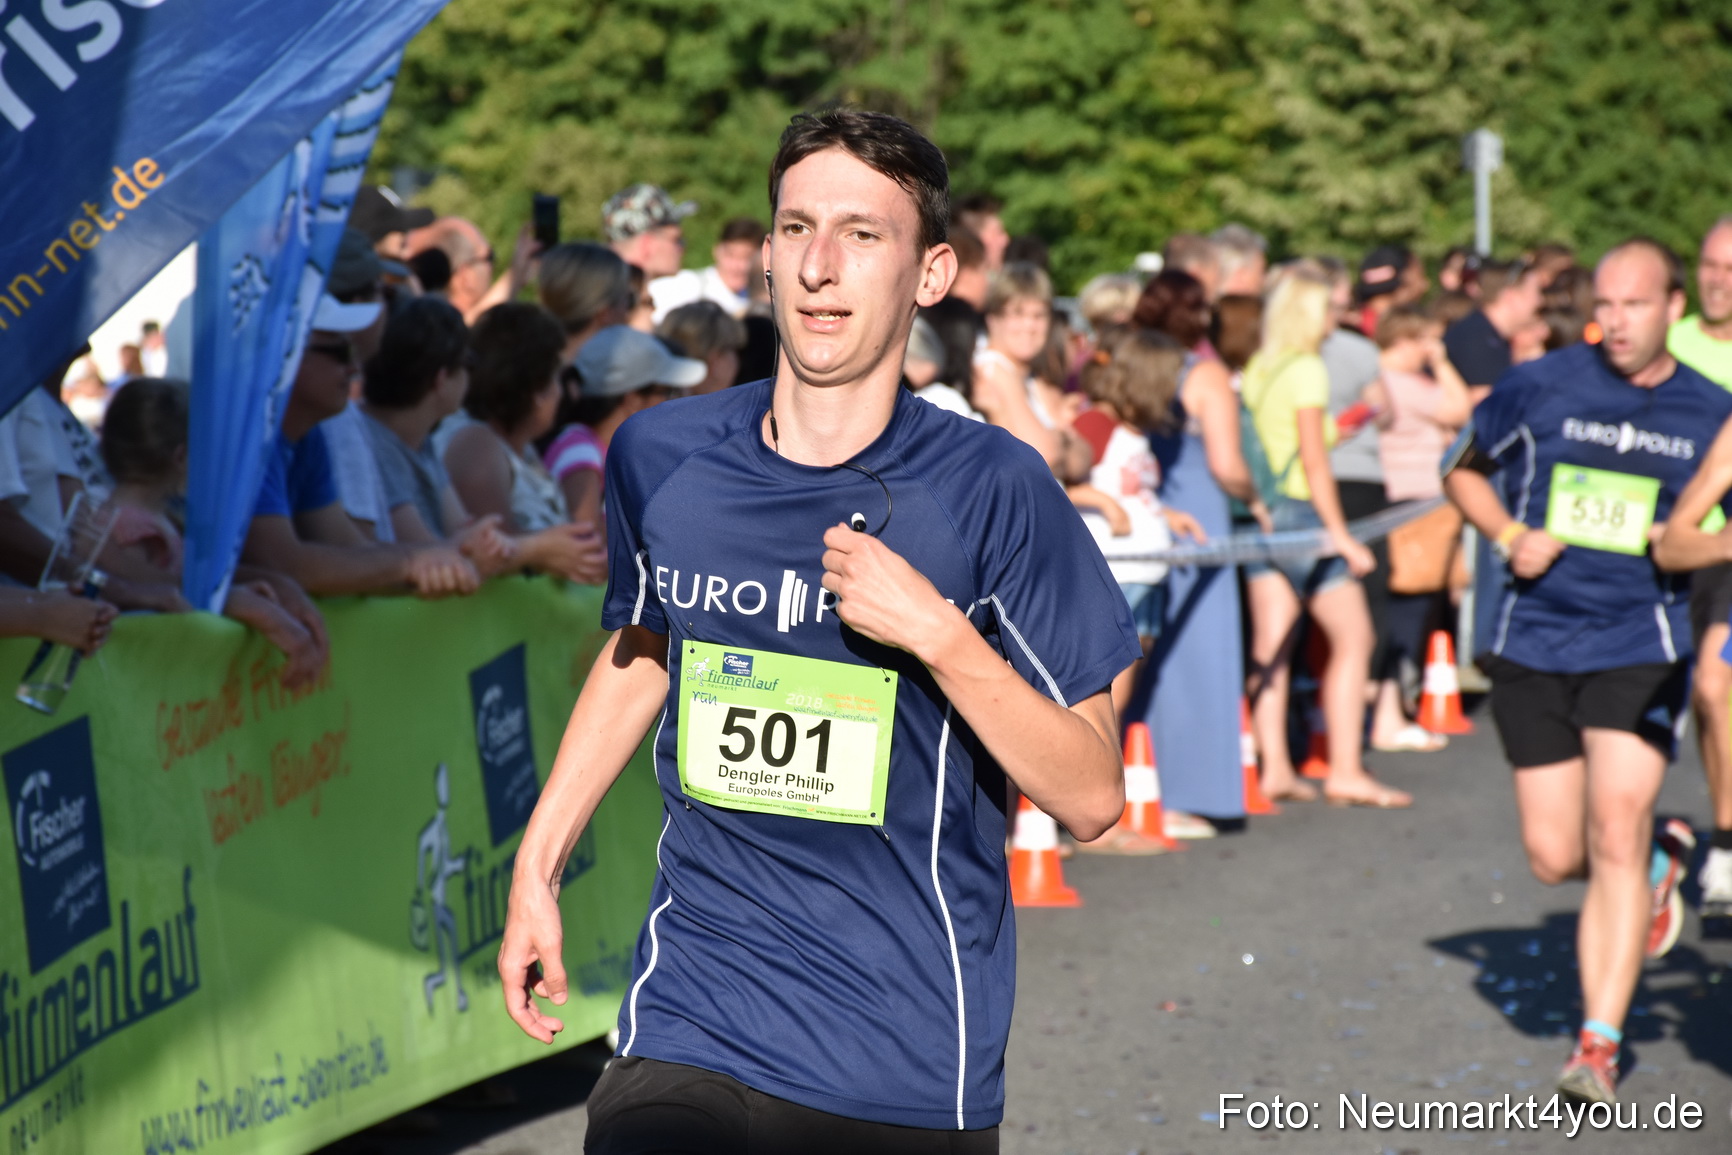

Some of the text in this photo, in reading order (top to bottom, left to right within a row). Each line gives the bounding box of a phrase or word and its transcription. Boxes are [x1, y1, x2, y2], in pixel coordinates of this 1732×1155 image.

[1562, 417, 1695, 460] EURO POLES
[1571, 495, 1628, 530] 538
[656, 565, 768, 616] EURO
[707, 669, 780, 691] firmenlauf
[785, 693, 823, 709] 2018
[718, 706, 832, 774] 501
[718, 764, 834, 793] Dengler Phillip
[728, 783, 783, 798] Europoles
[786, 789, 820, 803] GmbH
[0, 865, 199, 1103] firmenlauf
